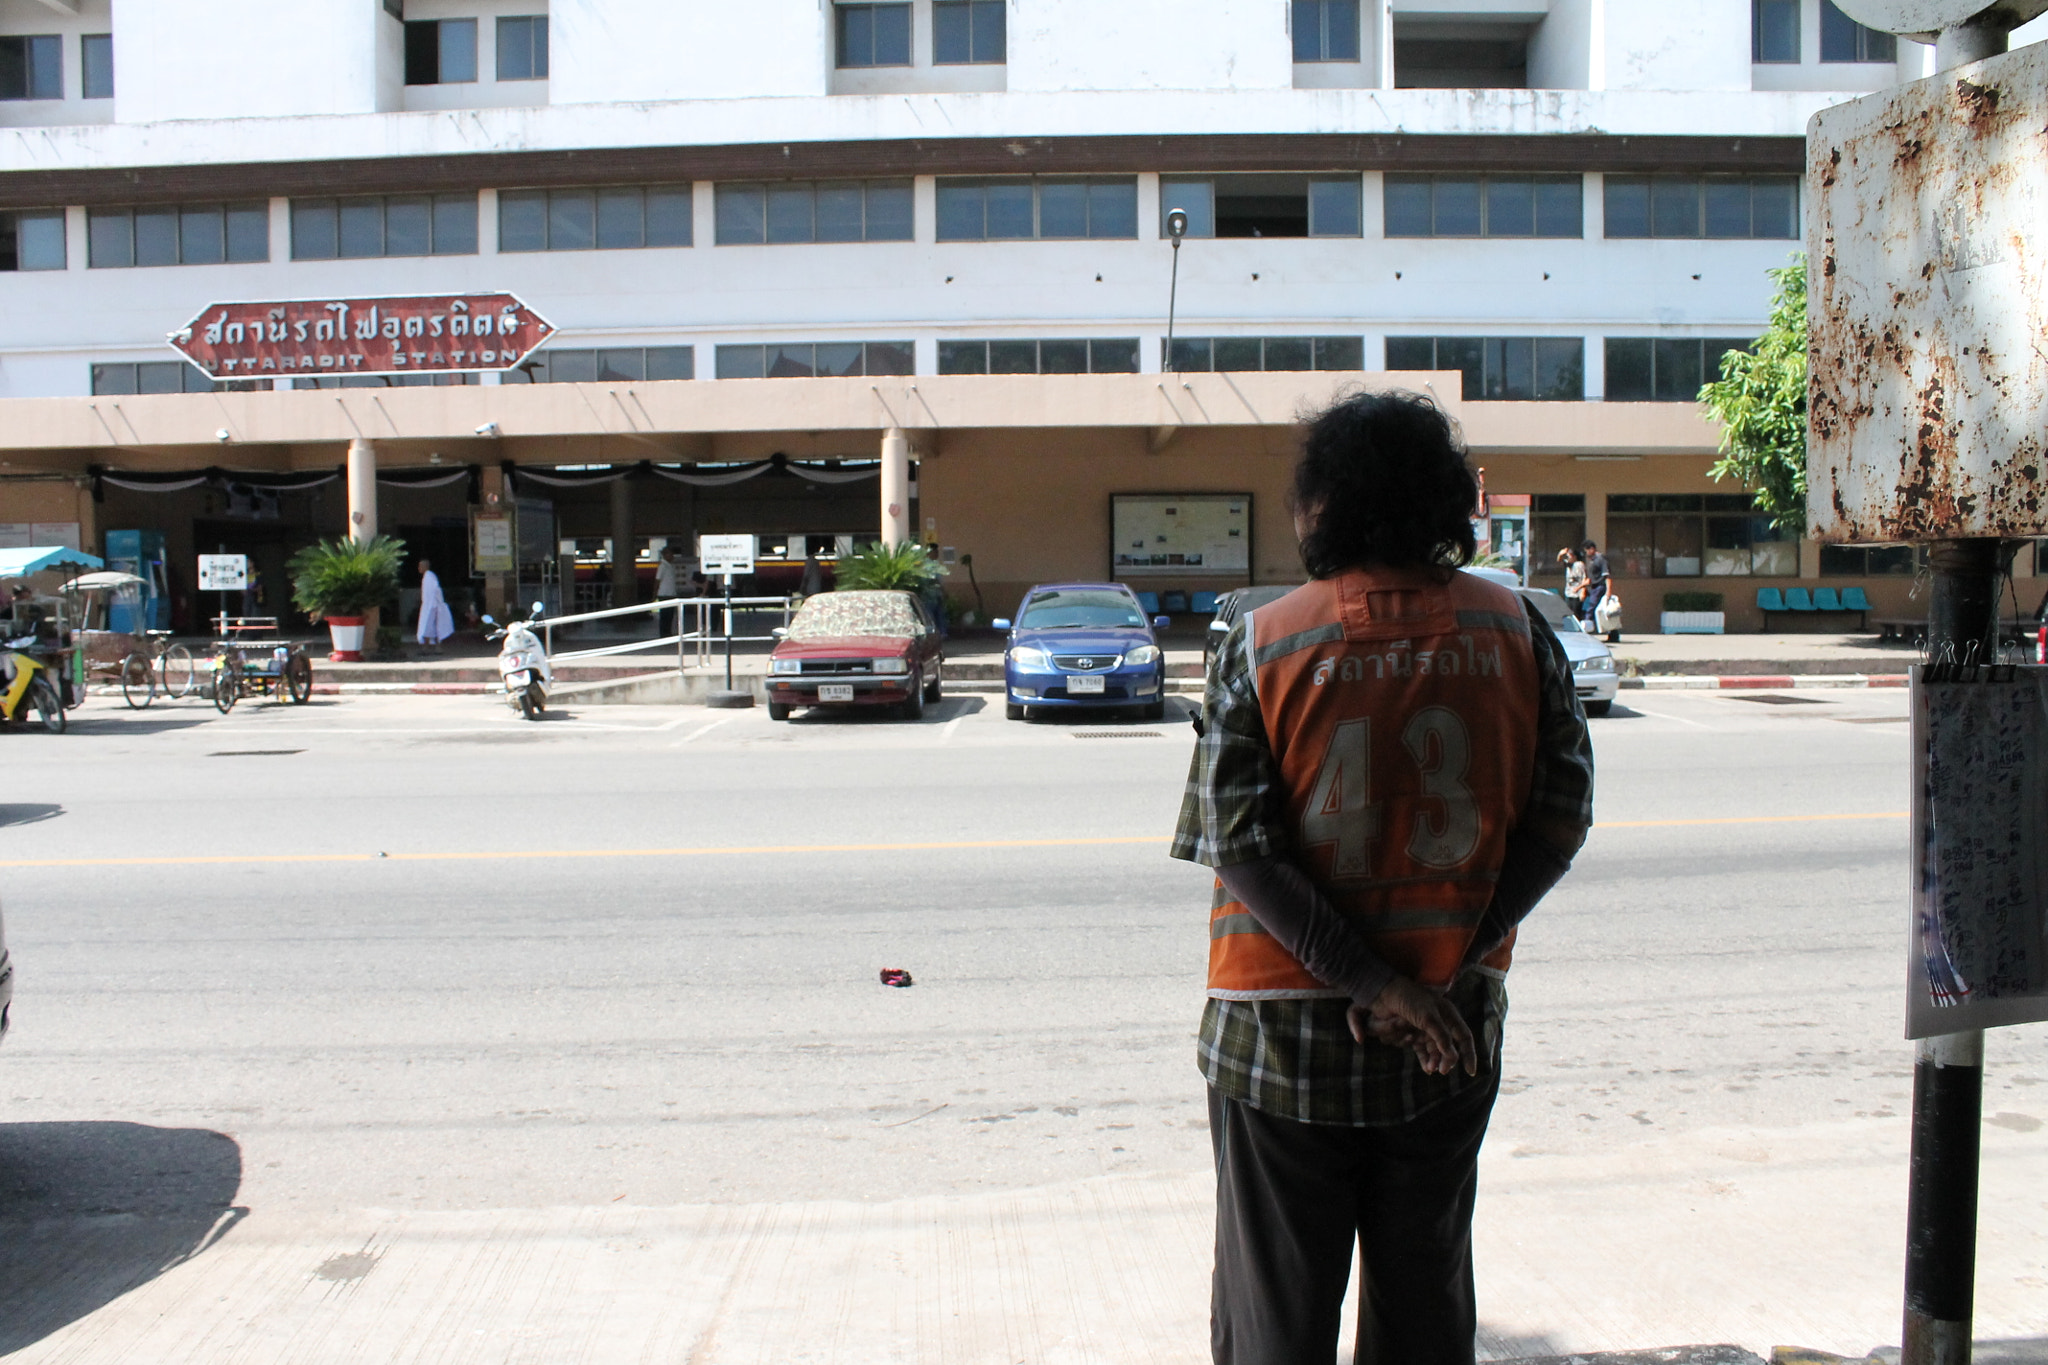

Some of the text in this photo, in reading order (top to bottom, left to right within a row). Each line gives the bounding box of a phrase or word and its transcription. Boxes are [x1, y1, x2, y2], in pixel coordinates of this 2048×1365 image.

[203, 349, 517, 372] UTTARADIT STATION
[1312, 634, 1503, 687] สถานีรถไฟ
[1302, 706, 1482, 880] 43
